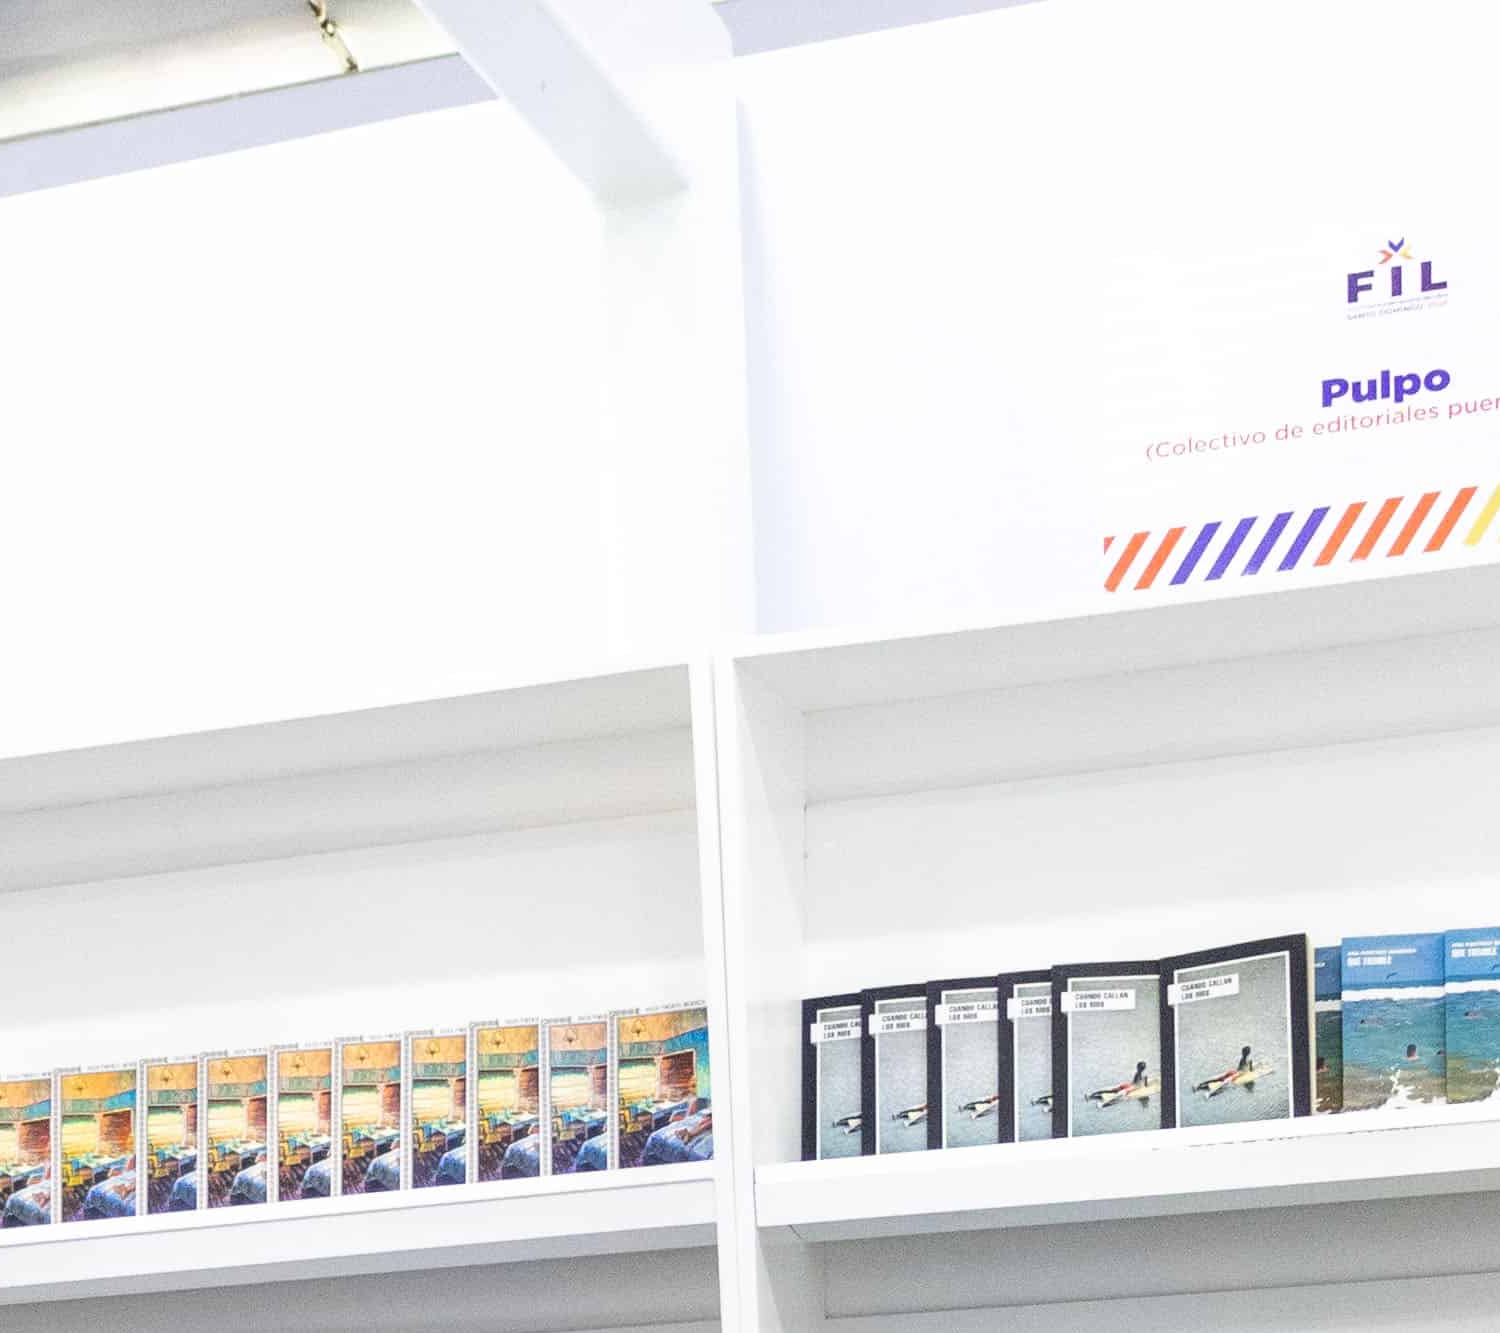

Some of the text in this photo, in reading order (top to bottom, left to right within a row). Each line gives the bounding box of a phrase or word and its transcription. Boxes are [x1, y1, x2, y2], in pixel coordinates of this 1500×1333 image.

[1347, 261, 1447, 303] FIL
[1321, 367, 1451, 408] Pulpo
[1146, 430, 1267, 462] (Colectivo
[1275, 421, 1304, 441] de
[1312, 403, 1439, 438] editoriales
